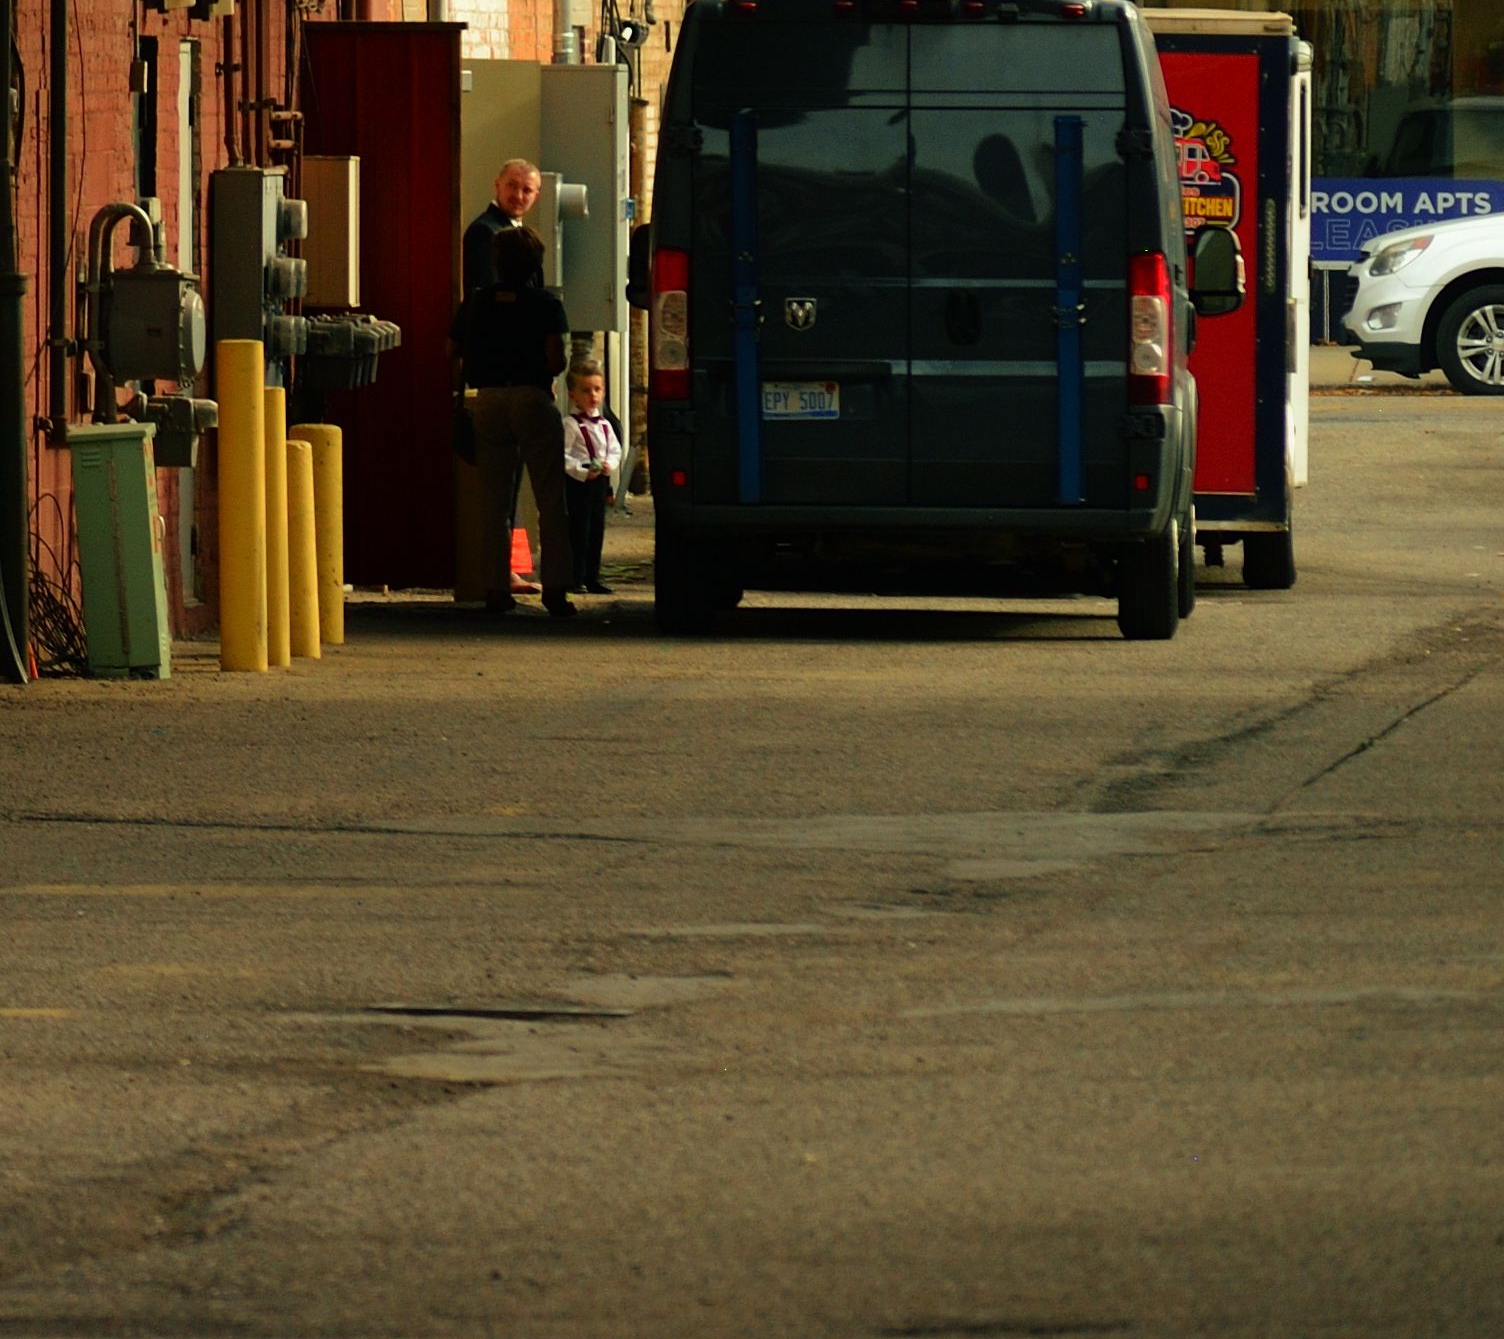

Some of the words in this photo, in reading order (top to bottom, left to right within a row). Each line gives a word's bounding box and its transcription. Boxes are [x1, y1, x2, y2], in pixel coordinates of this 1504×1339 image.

[1183, 197, 1233, 217] ITCHEN
[1312, 191, 1403, 214] ROOM
[1413, 191, 1492, 214] APTS
[765, 391, 789, 411] EPY
